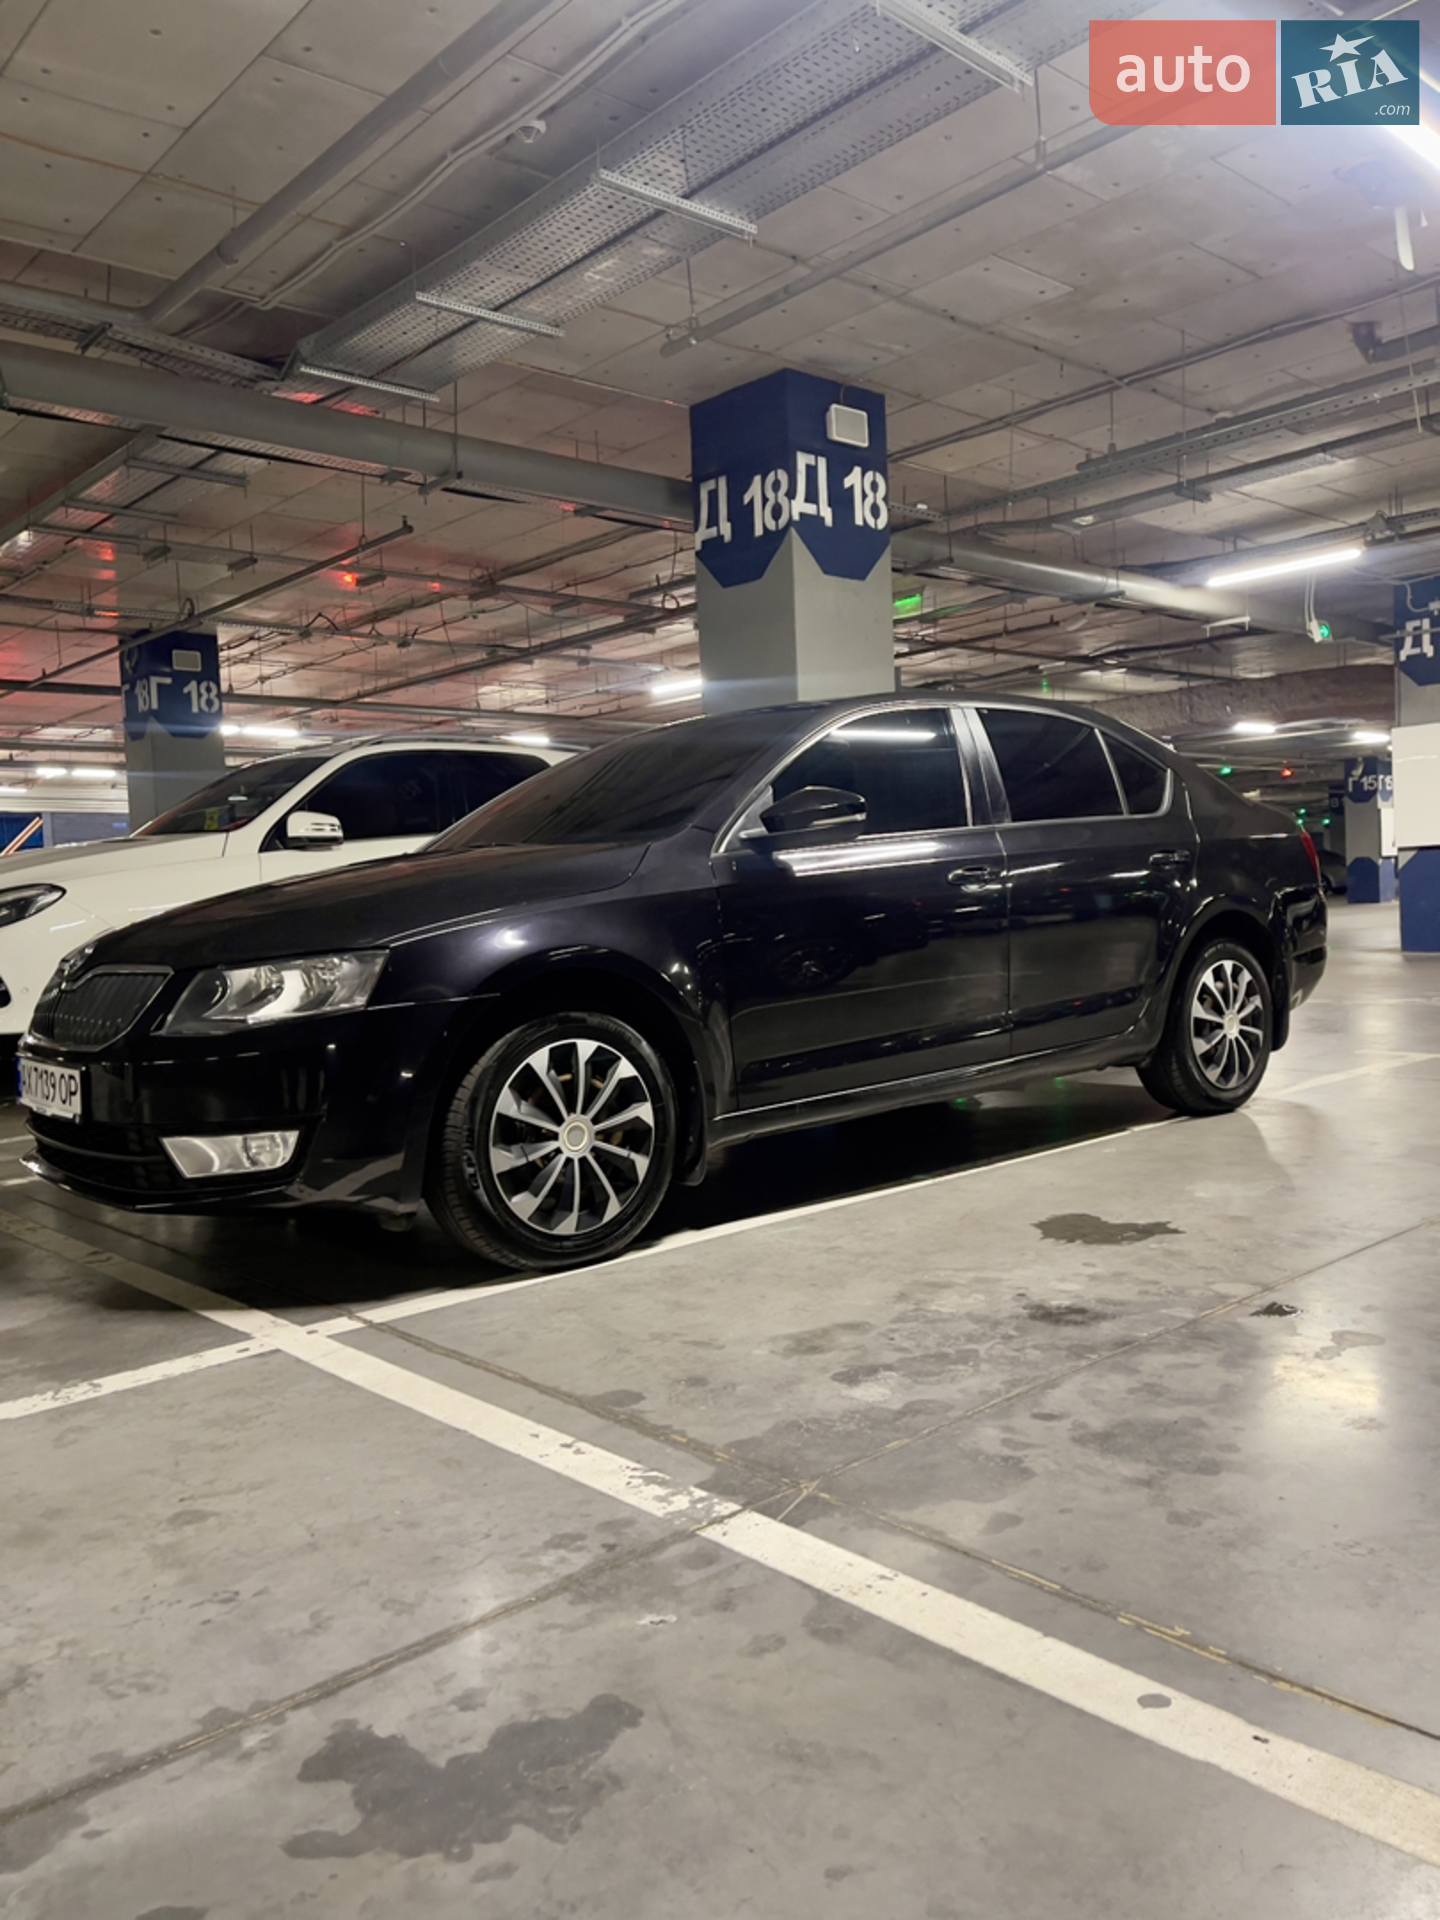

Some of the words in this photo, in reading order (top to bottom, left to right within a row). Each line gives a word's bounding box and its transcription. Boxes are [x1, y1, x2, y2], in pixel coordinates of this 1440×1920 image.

[695, 475, 732, 551] Д
[743, 468, 791, 538] 18
[790, 451, 833, 528] Д
[843, 465, 889, 531] 18
[1399, 618, 1434, 662] Д
[149, 675, 173, 710] Г
[183, 680, 220, 714] 18
[1360, 774, 1378, 792] 15
